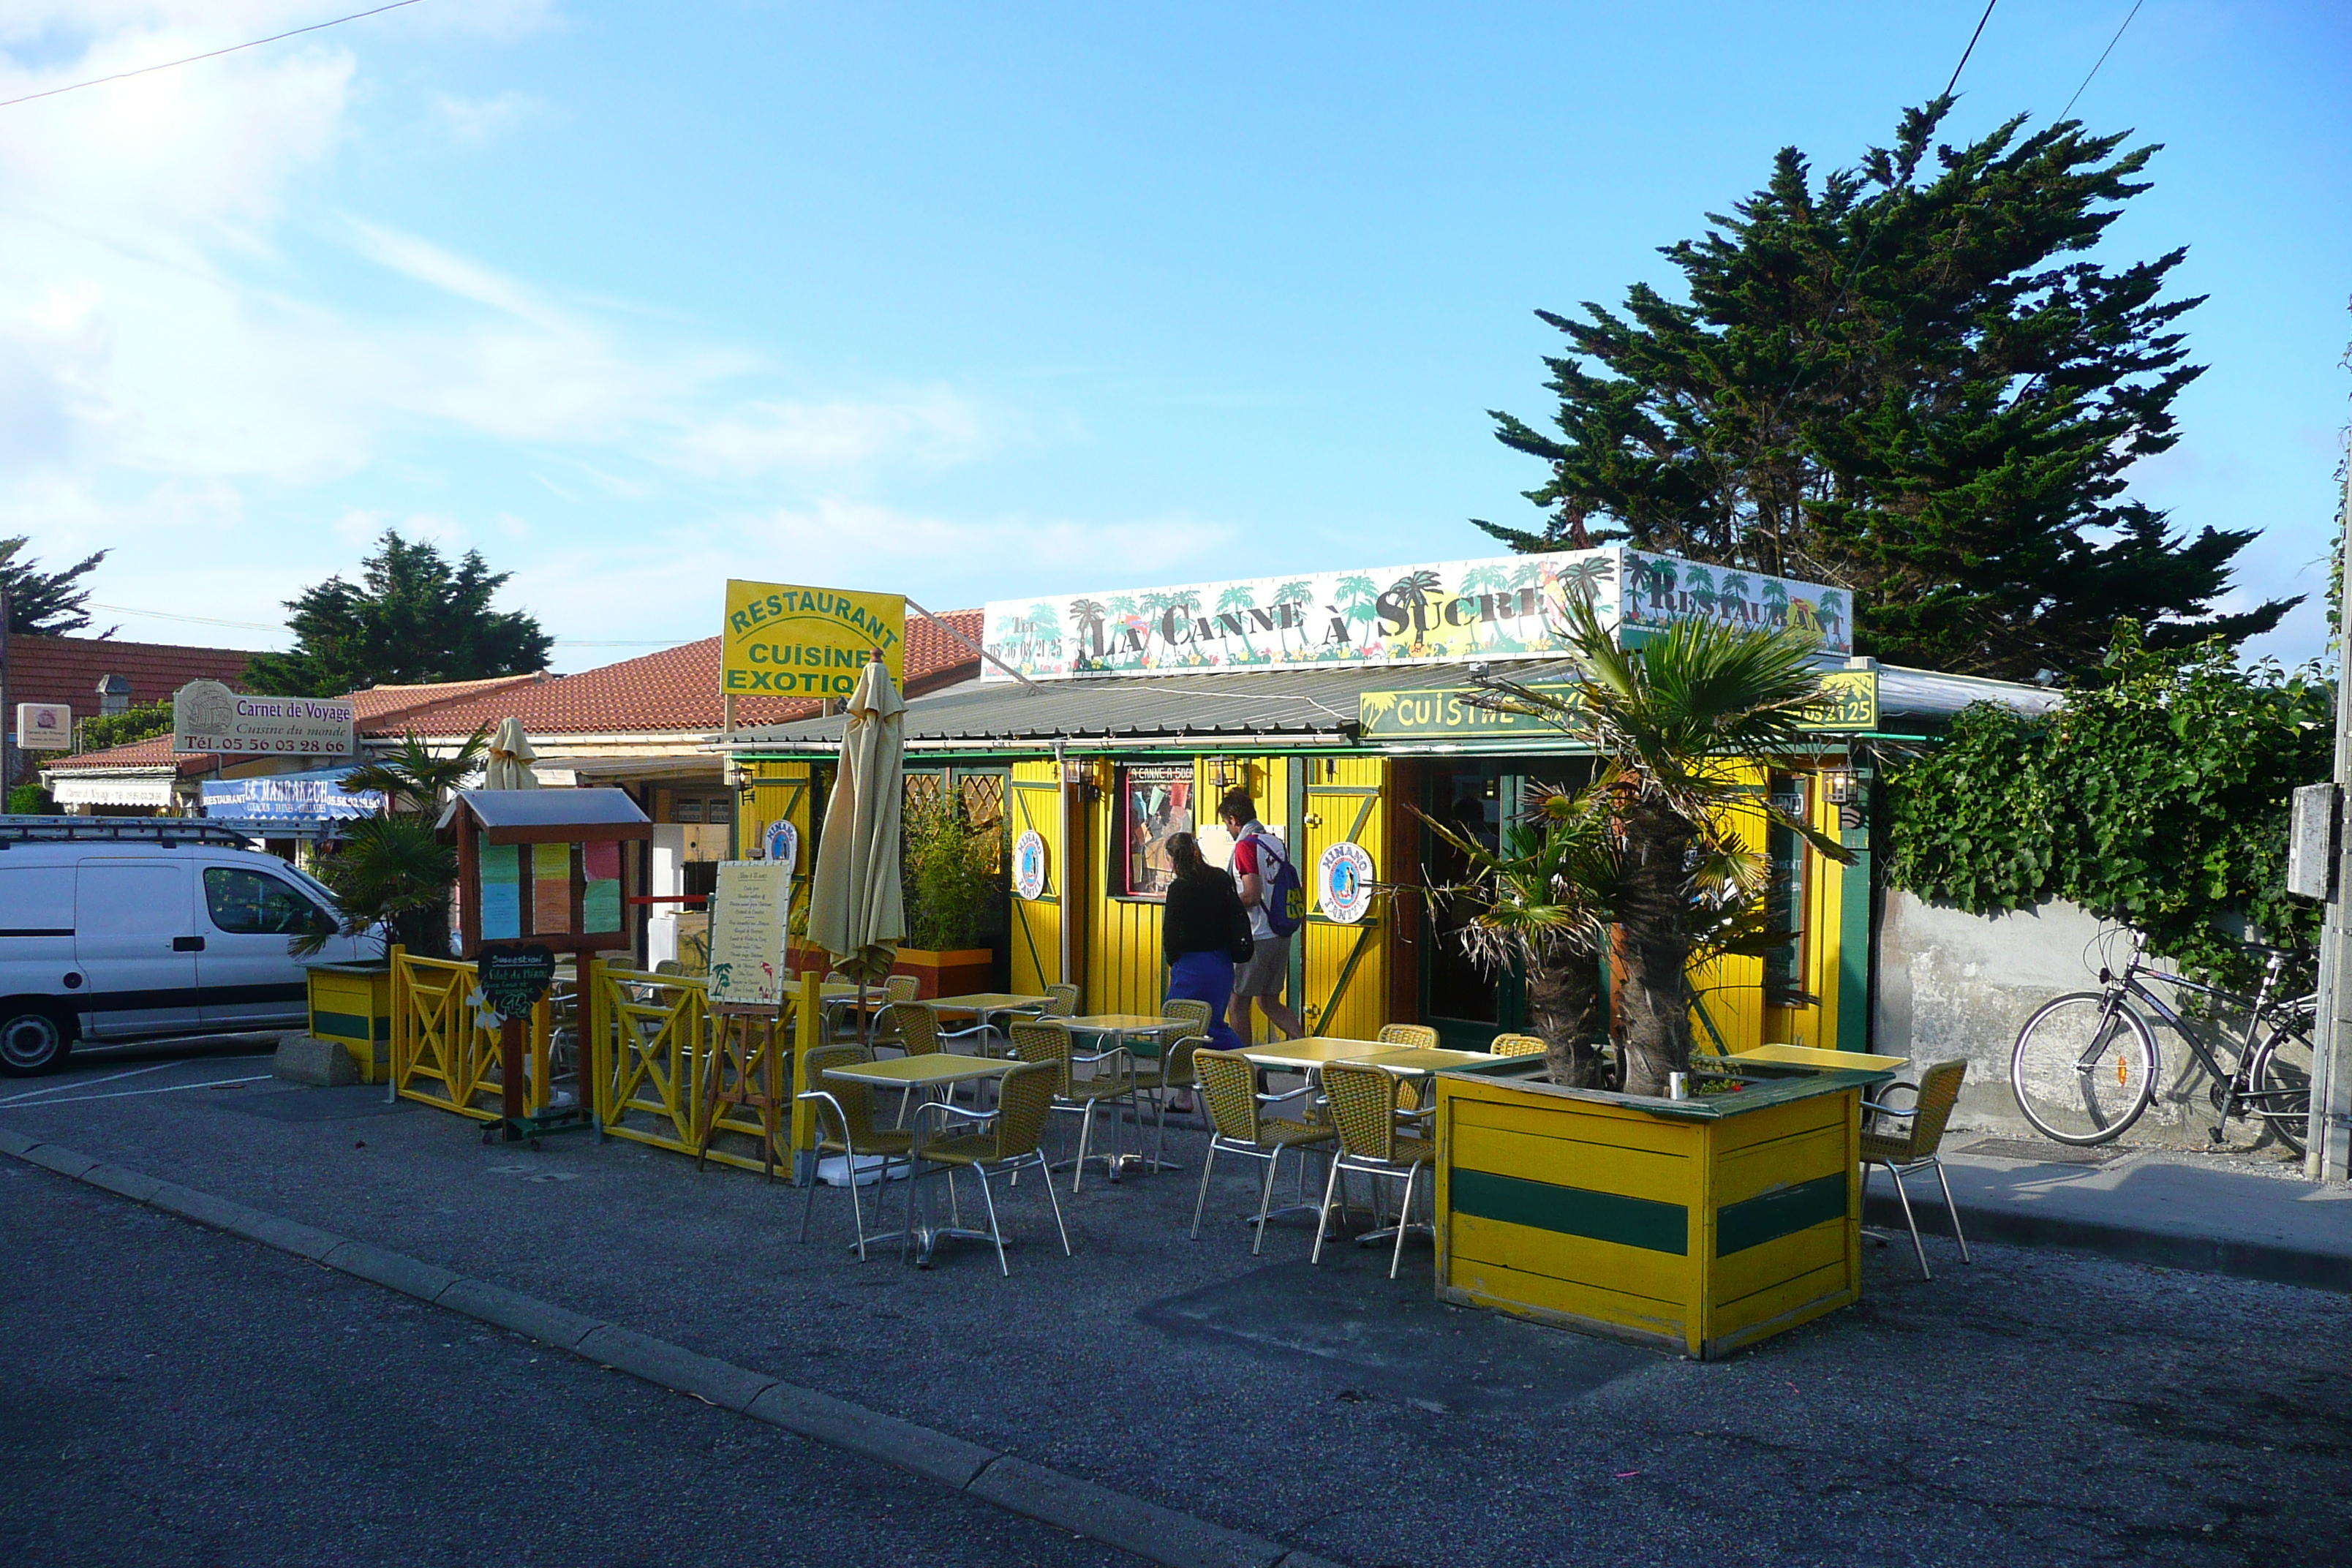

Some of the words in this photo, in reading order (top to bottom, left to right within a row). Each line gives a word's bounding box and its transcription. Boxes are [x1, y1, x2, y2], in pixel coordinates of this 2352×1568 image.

[1648, 571, 1844, 636] RESTAURANT
[730, 591, 898, 650] RESTAURANT
[1091, 618, 1145, 657] LA
[1161, 601, 1304, 646] CANNE
[1322, 605, 1352, 645] À
[1376, 587, 1550, 638] SUCRE
[749, 643, 871, 668] CUISINE
[1051, 638, 1062, 657] 25
[727, 669, 897, 695] EXOTIQ
[236, 700, 282, 717] Carnet
[287, 702, 301, 718] de
[305, 702, 350, 723] Voyage
[1848, 701, 1870, 721] 25
[236, 723, 284, 735] Cuisine
[287, 724, 302, 736] du
[307, 725, 347, 737] monde
[222, 738, 243, 750] 05
[249, 739, 269, 750] 56
[275, 740, 294, 752] 03
[301, 740, 320, 752] 28
[325, 740, 344, 752] 66
[203, 794, 246, 806] RESTAURANT
